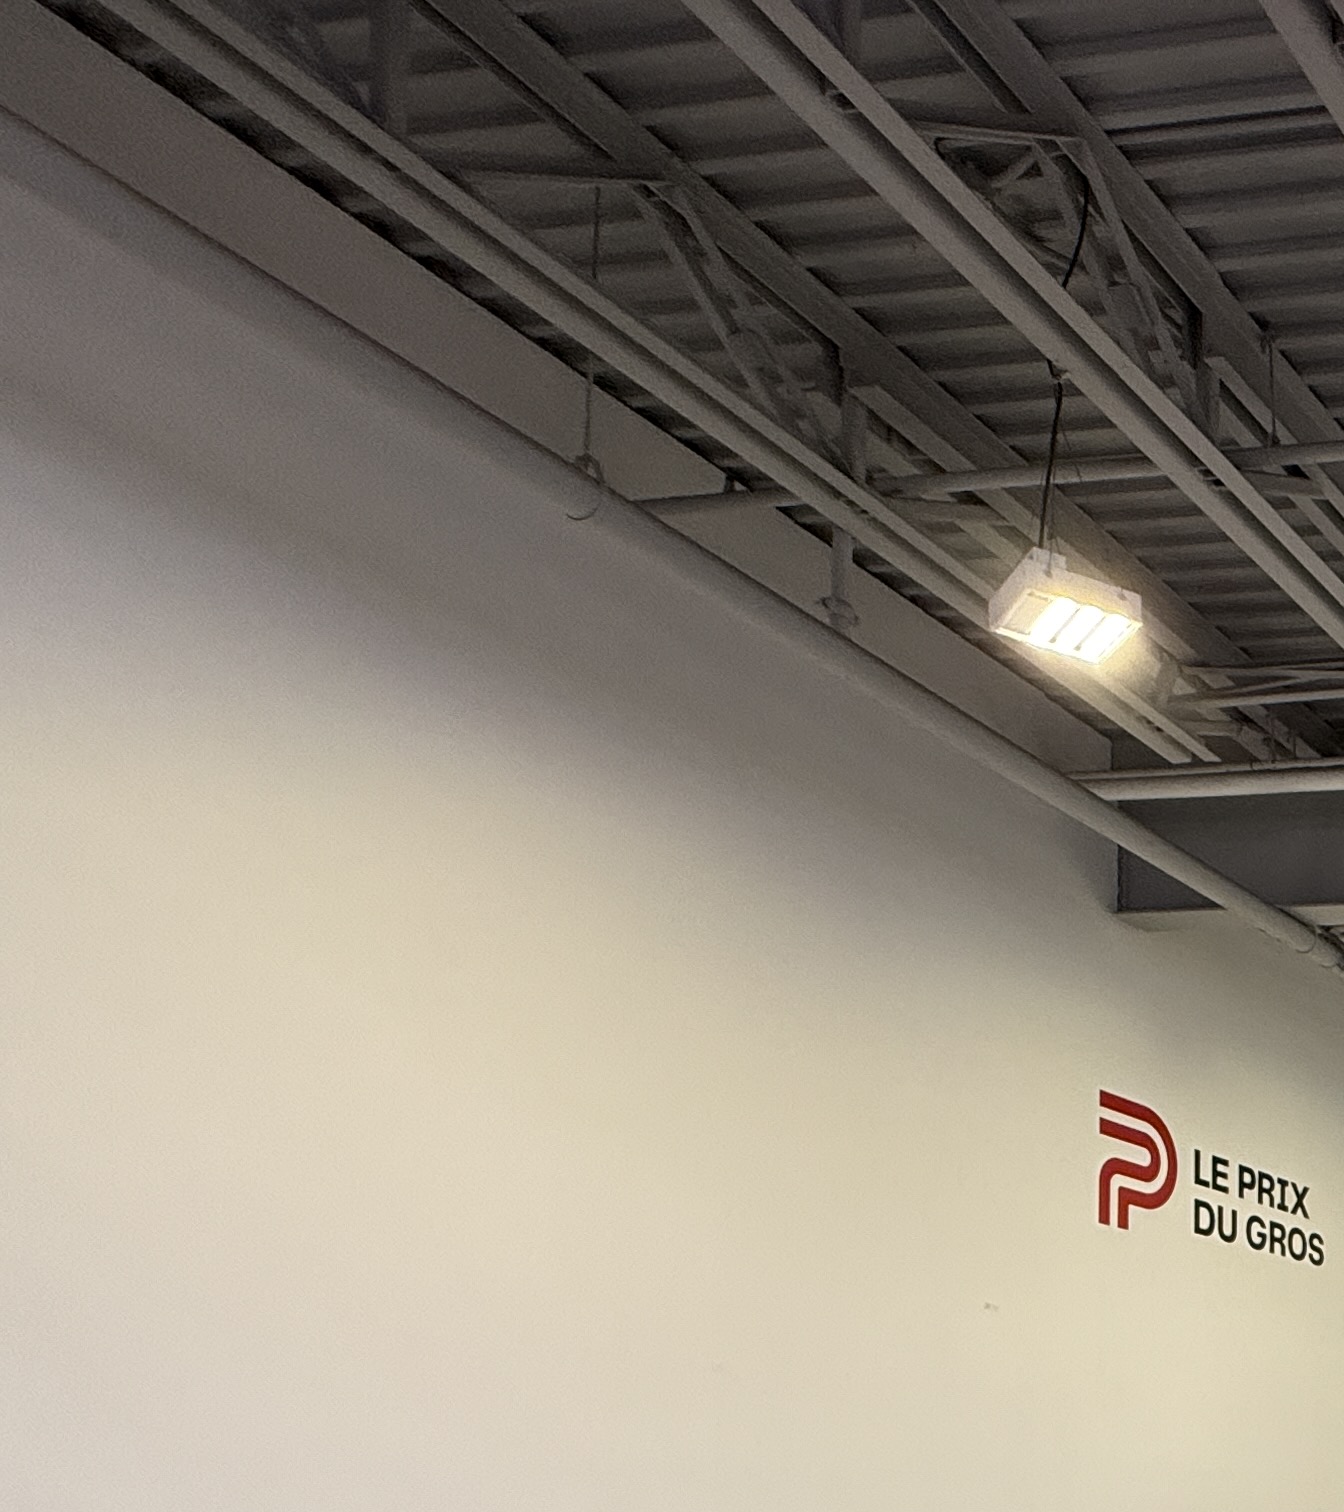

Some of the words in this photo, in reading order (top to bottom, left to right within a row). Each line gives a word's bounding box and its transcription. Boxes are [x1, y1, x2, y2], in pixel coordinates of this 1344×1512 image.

[1194, 1148, 1230, 1195] LE
[1238, 1164, 1310, 1220] PRIX
[1194, 1198, 1238, 1244] DU
[1245, 1214, 1326, 1267] GROS
